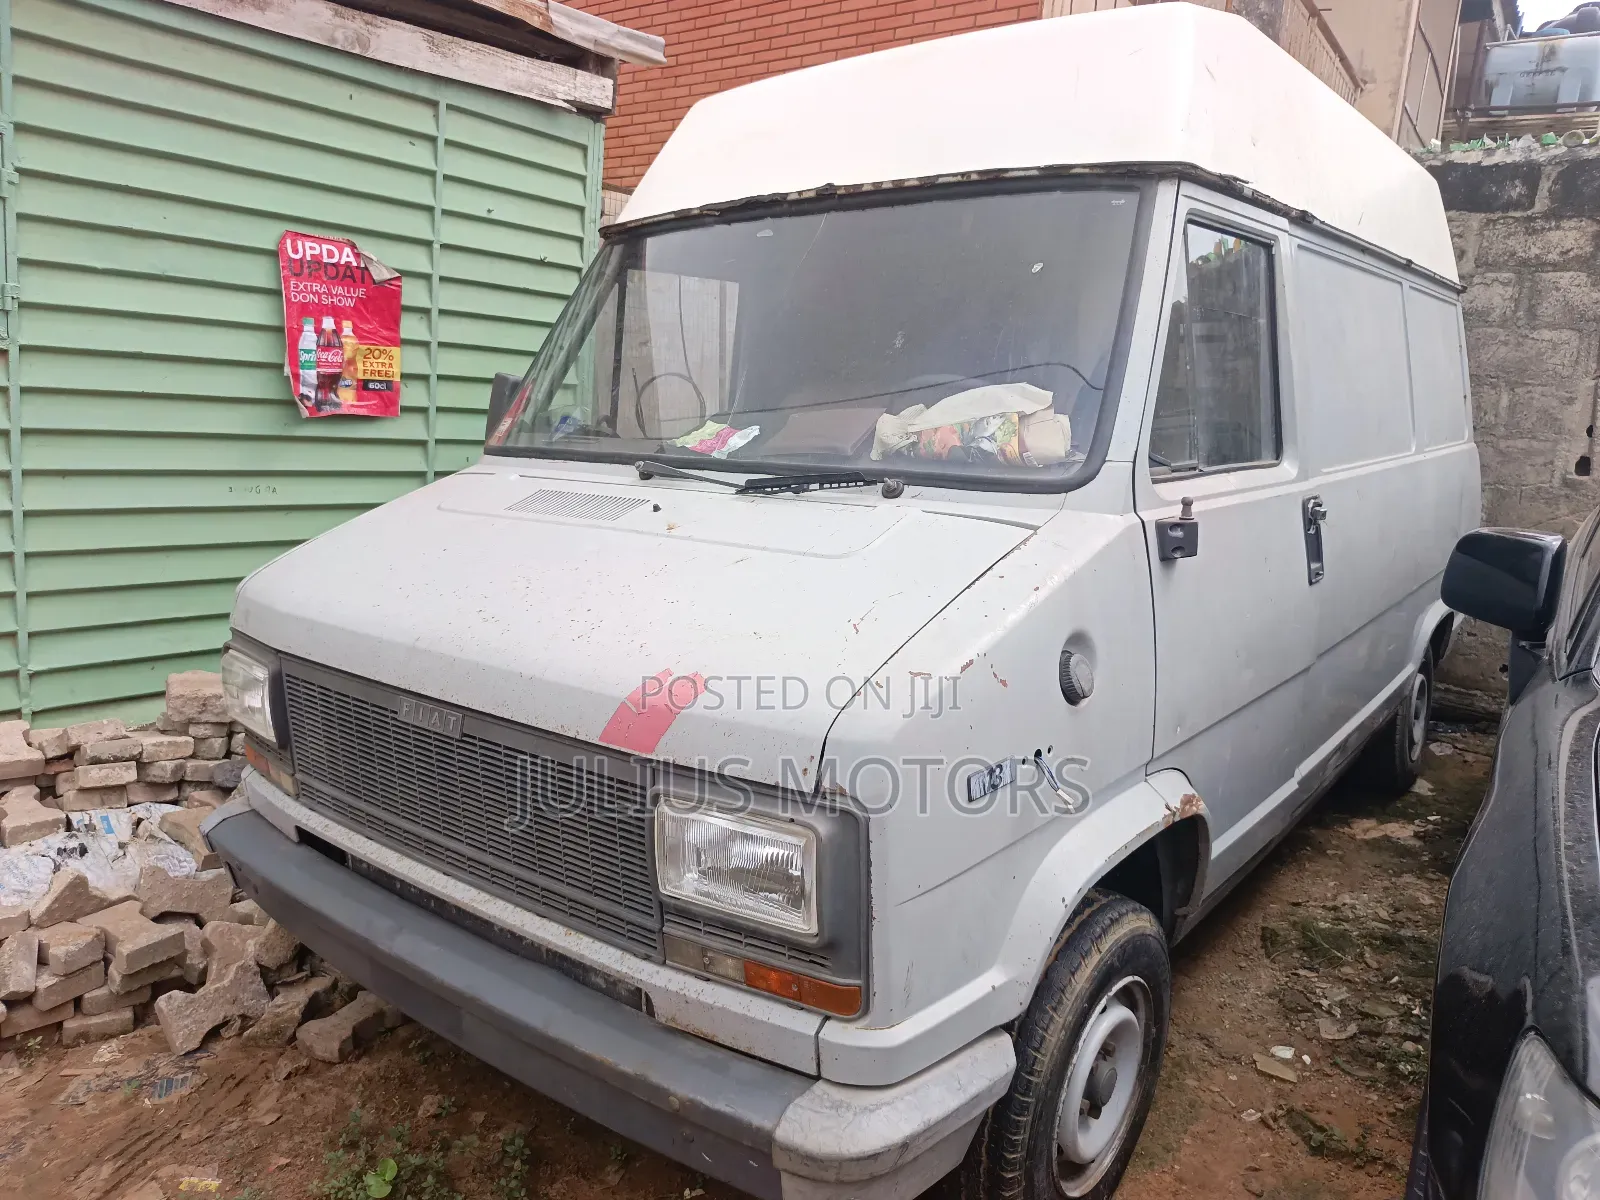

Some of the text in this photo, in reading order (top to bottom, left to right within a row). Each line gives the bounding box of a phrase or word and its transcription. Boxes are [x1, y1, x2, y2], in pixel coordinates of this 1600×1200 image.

[290, 281, 367, 298] EXTRA VALUE
[291, 292, 356, 307] DON SHOW
[363, 347, 394, 361] 20%
[362, 361, 394, 369] EXTRA
[362, 369, 395, 378] FREE!
[368, 382, 387, 390] 60cl
[403, 702, 457, 732] FIAT
